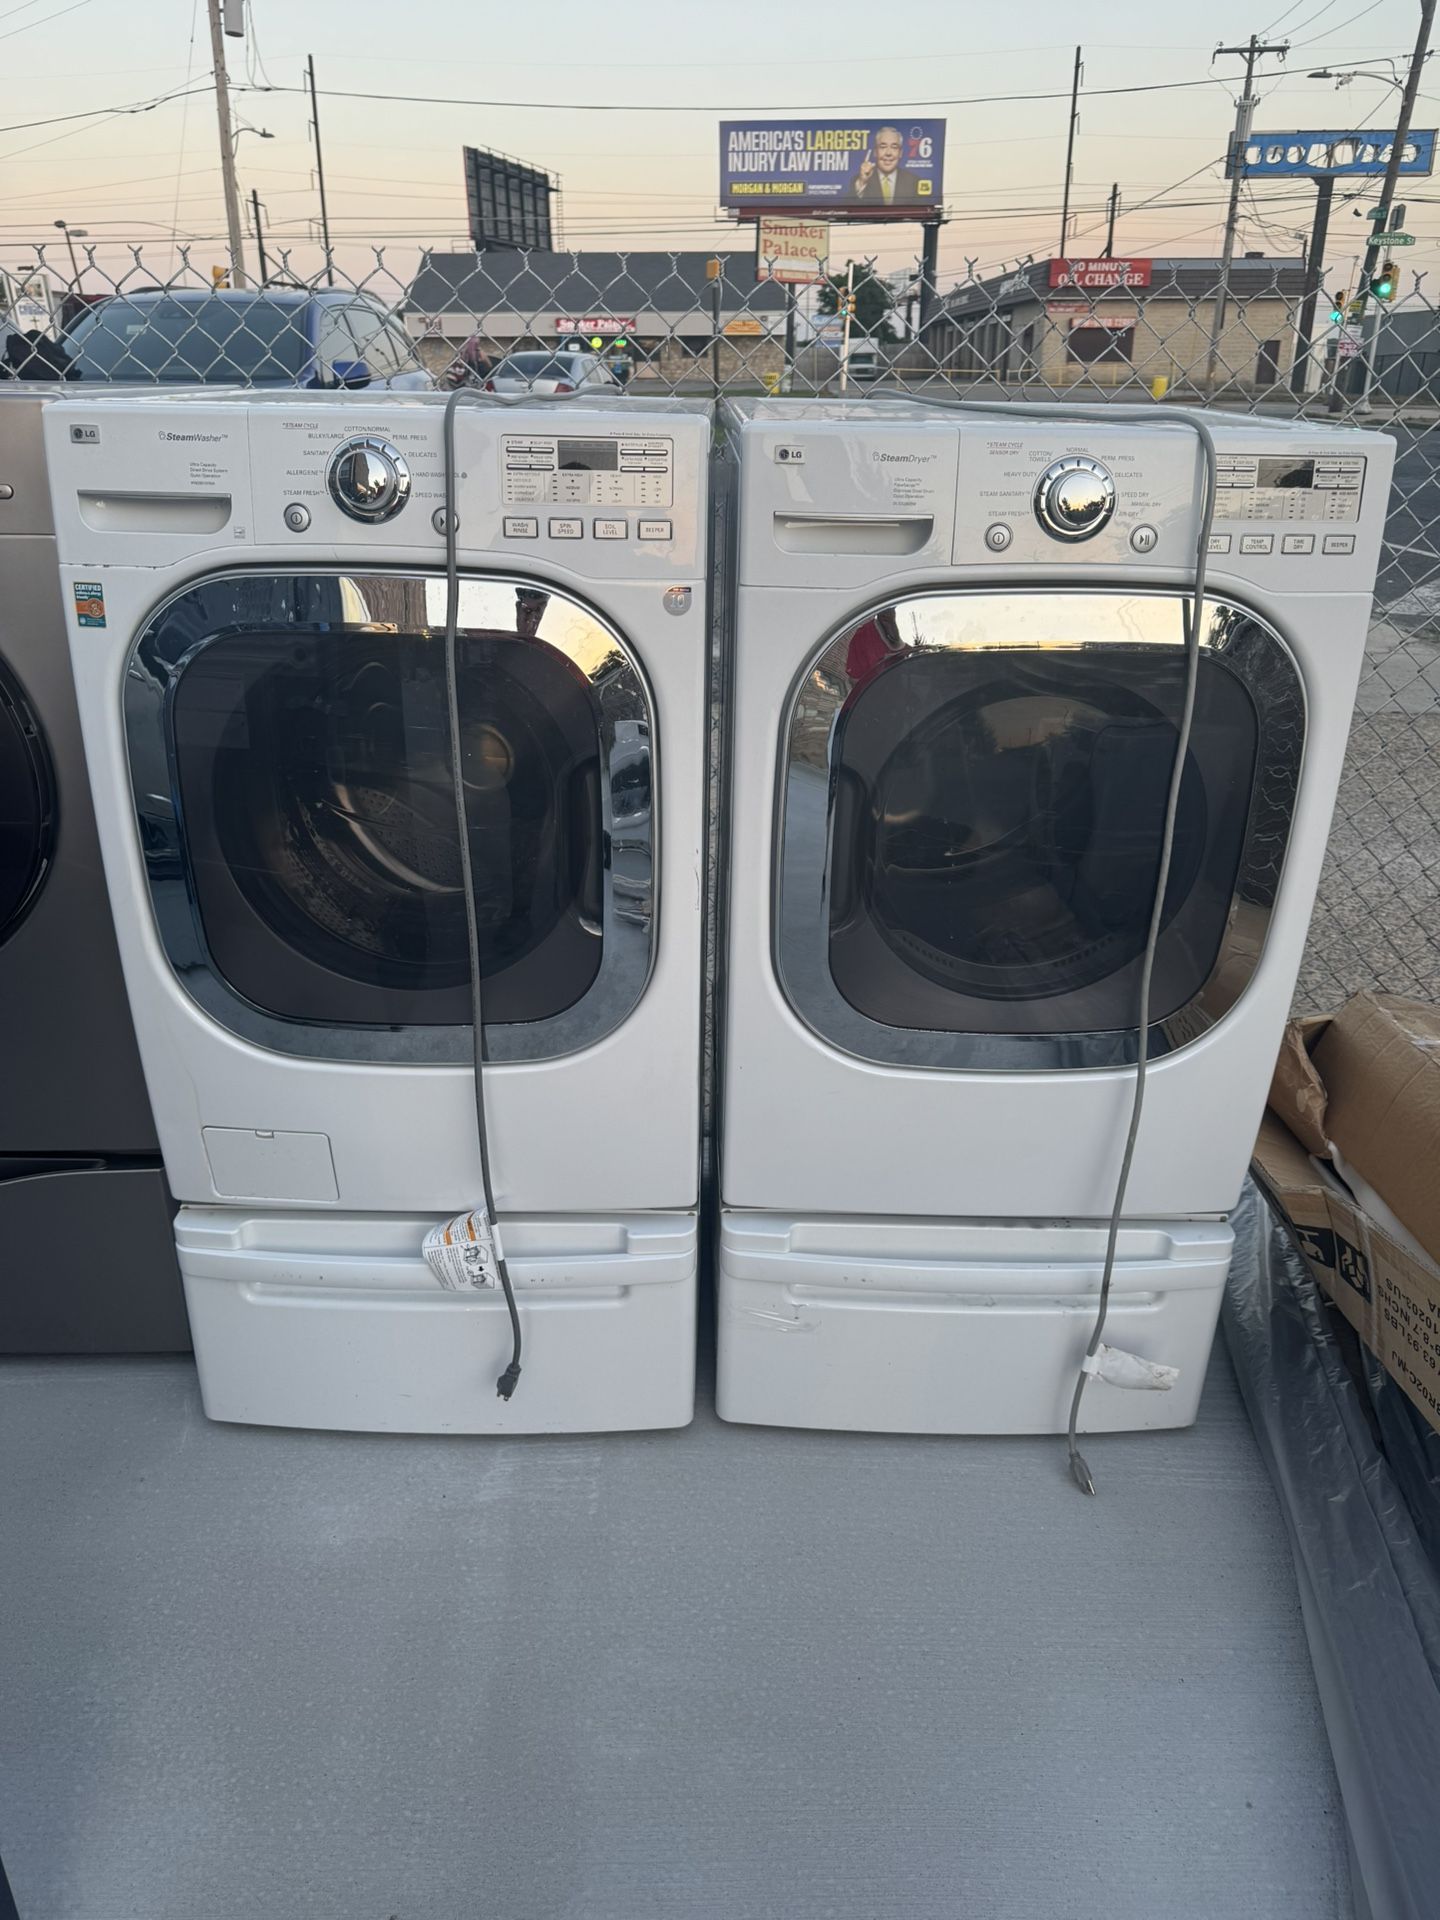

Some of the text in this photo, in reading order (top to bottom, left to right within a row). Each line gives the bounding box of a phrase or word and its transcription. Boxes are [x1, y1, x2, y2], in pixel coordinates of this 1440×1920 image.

[728, 130, 870, 151] AMERICA'S LARGEST
[908, 137, 933, 158] 76
[728, 151, 849, 172] INJURY LAW FIRM
[731, 183, 763, 194] MORGAN
[765, 183, 770, 193] &
[772, 183, 804, 194] MORGAN
[762, 219, 826, 239] Smoker
[762, 239, 817, 257] Palace
[1369, 237, 1416, 246] Keystone St
[1086, 273, 1144, 286] CHANGE
[85, 430, 96, 438] LG
[791, 451, 802, 459] LG
[1384, 1308, 1405, 1337] LBS
